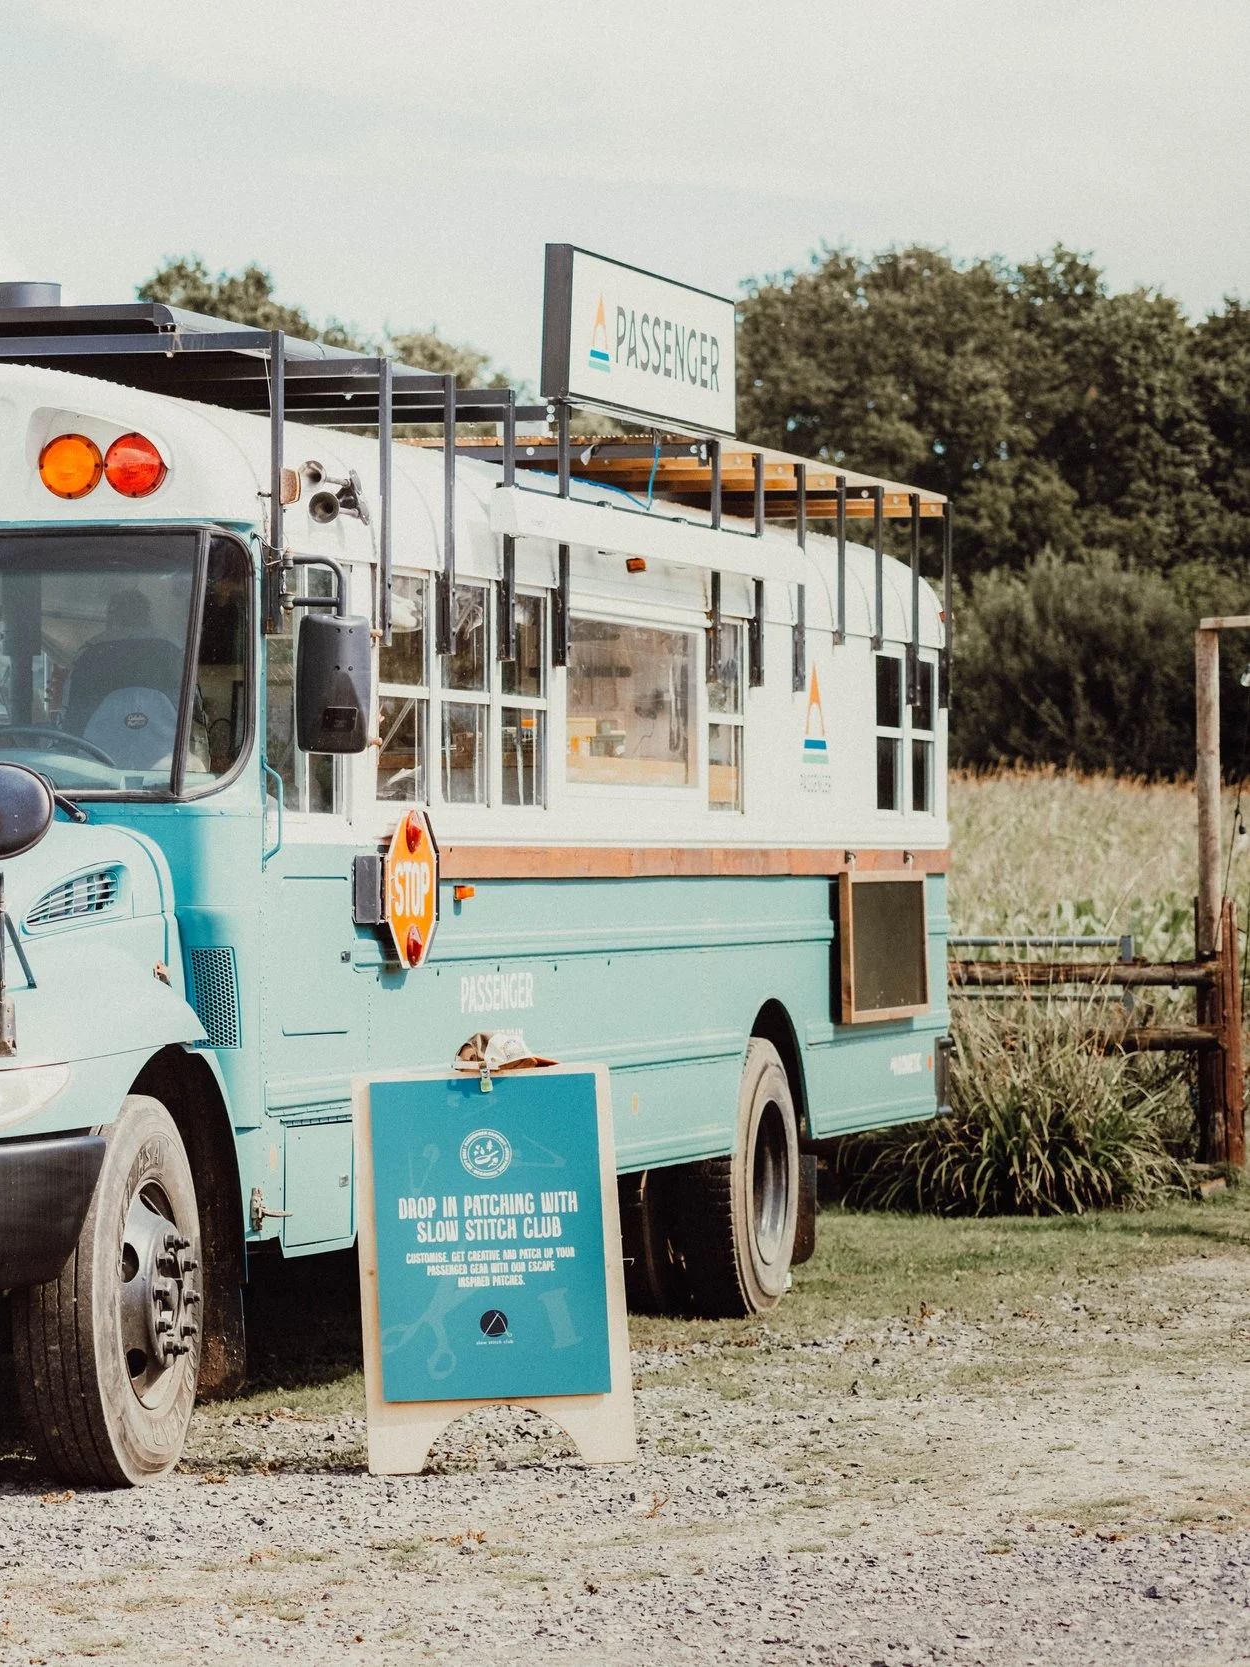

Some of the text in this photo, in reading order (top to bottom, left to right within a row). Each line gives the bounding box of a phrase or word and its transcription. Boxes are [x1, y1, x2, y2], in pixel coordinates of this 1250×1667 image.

[615, 305, 720, 392] PASSENGER
[394, 860, 431, 918] STOP
[460, 972, 534, 1013] PASSENGER
[398, 1190, 579, 1220] DROP IN PATCHING WITH
[416, 1215, 563, 1244] SLOW STITCH CLUB
[426, 1260, 556, 1276] PASSENGER GEAR WITH OUR ESCAPE
[451, 1250, 465, 1262] GET
[467, 1249, 501, 1262] CREATIVE
[502, 1248, 517, 1261] AND
[519, 1247, 542, 1260] PATCH
[543, 1247, 554, 1259] UP
[555, 1246, 576, 1258] YOUR
[457, 1274, 526, 1288] INSPIRED PATCHES.
